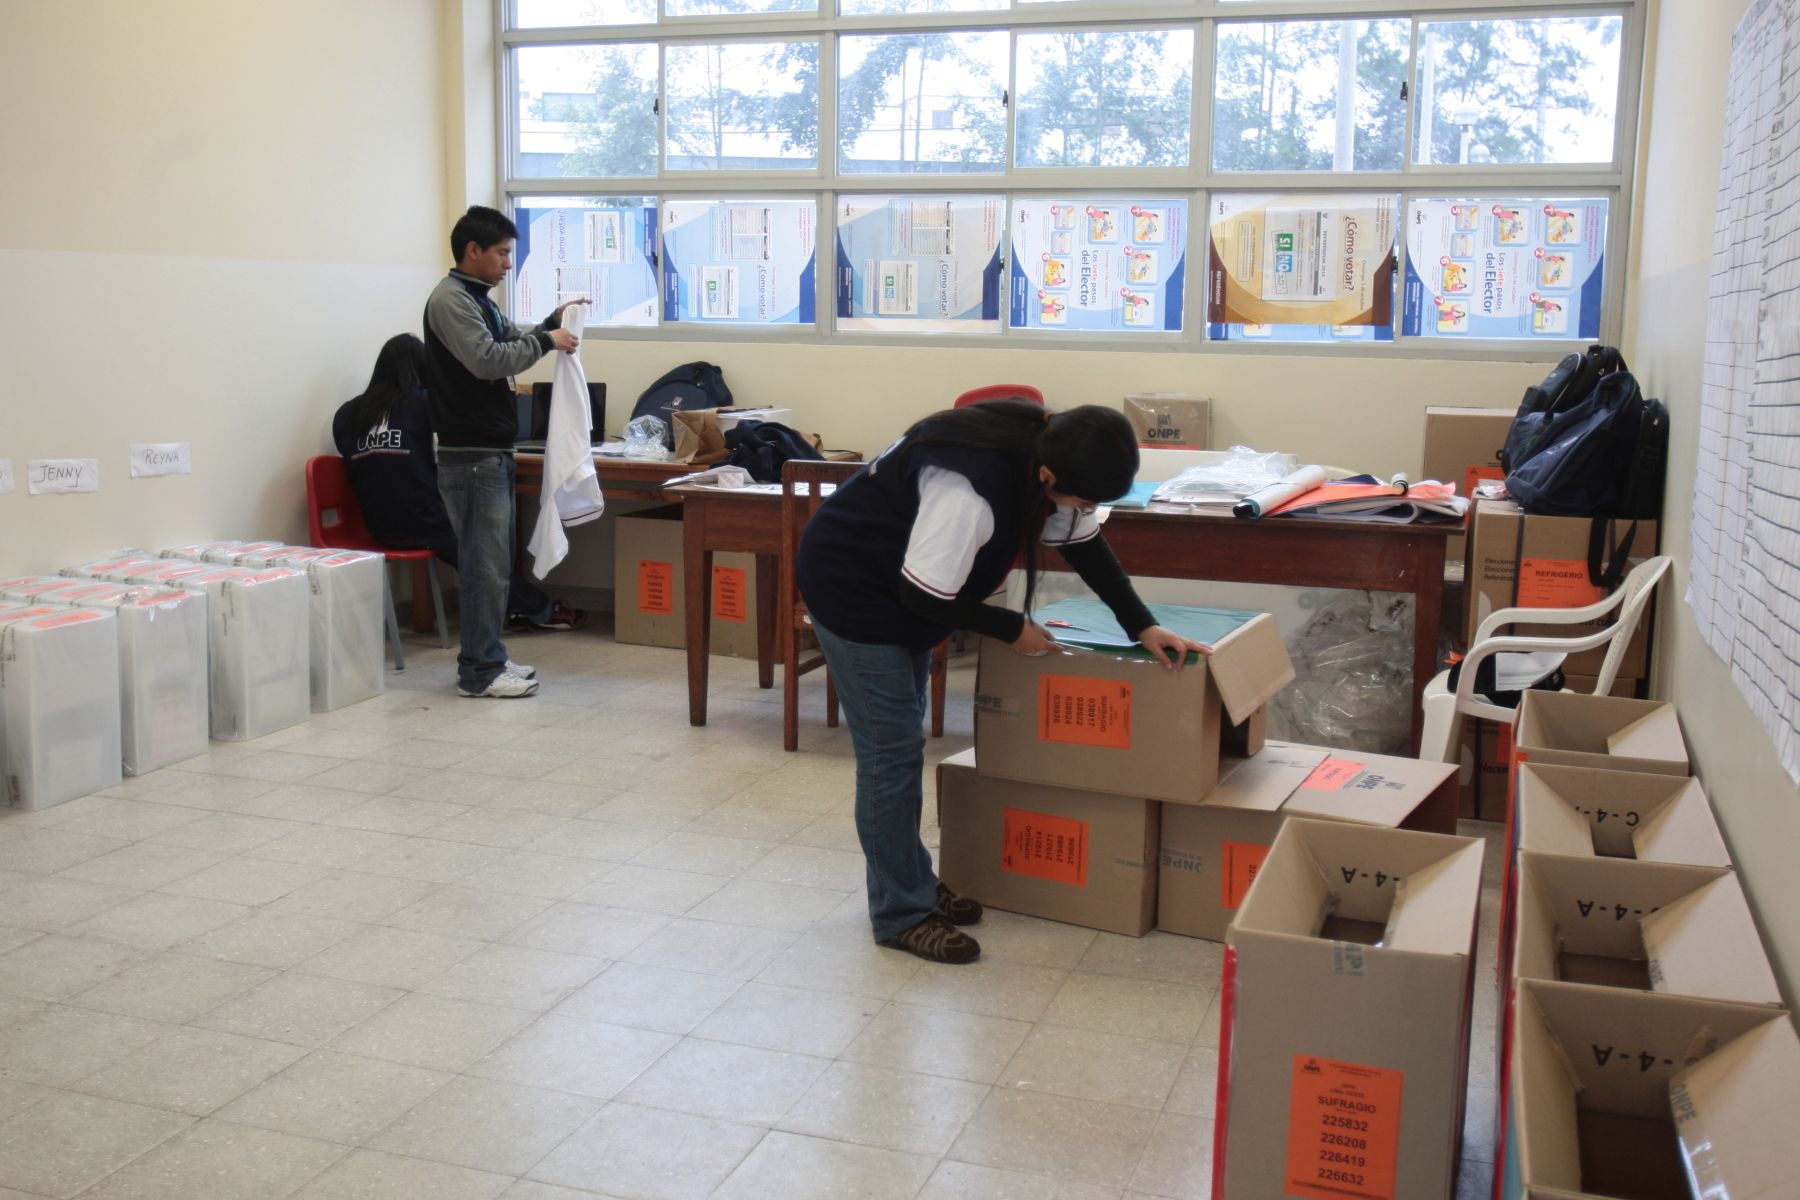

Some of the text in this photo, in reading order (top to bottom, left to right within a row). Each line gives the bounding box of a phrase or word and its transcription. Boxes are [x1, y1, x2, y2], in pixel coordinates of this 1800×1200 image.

[1344, 216, 1357, 290] ¿Cómo votar?
[938, 260, 949, 288] ¿Cómo
[1080, 250, 1090, 307] del Elector
[1483, 253, 1496, 314] del Elector
[1497, 267, 1505, 286] siete
[1495, 288, 1503, 310] pasos
[1148, 428, 1181, 439] ONPE
[143, 449, 179, 465] REYNA
[34, 465, 82, 487] JENNY
[1535, 570, 1583, 580] REFRIGERIO
[1576, 806, 1639, 826] C-4-
[1341, 866, 1401, 888] -4-A
[1577, 899, 1659, 921] -4-A
[1592, 1044, 1700, 1073] -4-A
[1317, 1095, 1376, 1114] SUFRAGIO
[1671, 1083, 1696, 1124] ONPE
[1322, 1114, 1368, 1132] 225832
[1320, 1132, 1367, 1150] 226208
[1319, 1150, 1365, 1167] 226419
[1317, 1167, 1364, 1185] 226632
